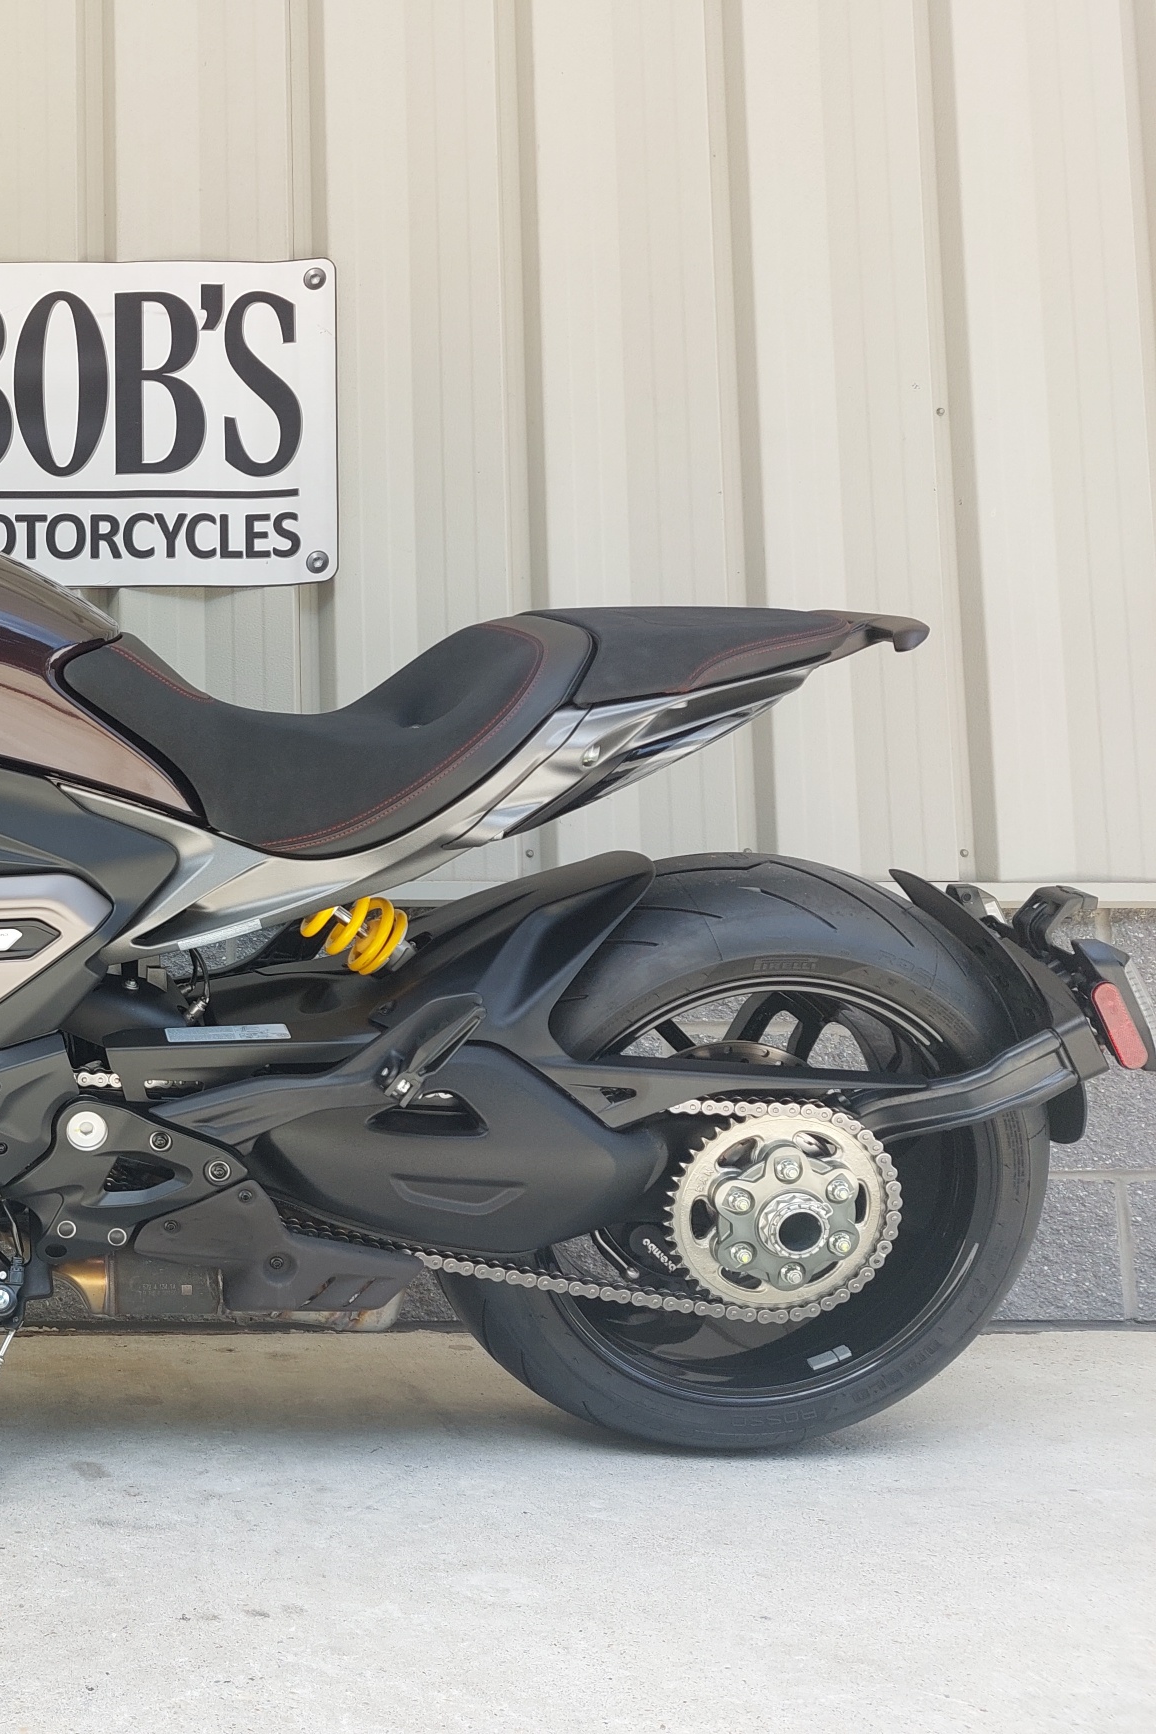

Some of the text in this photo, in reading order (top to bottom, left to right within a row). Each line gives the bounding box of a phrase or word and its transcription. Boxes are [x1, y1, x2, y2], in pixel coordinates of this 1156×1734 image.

[751, 957, 819, 972] PIRELLI
[642, 1238, 677, 1274] brembo
[732, 1408, 818, 1428] ROSSO
